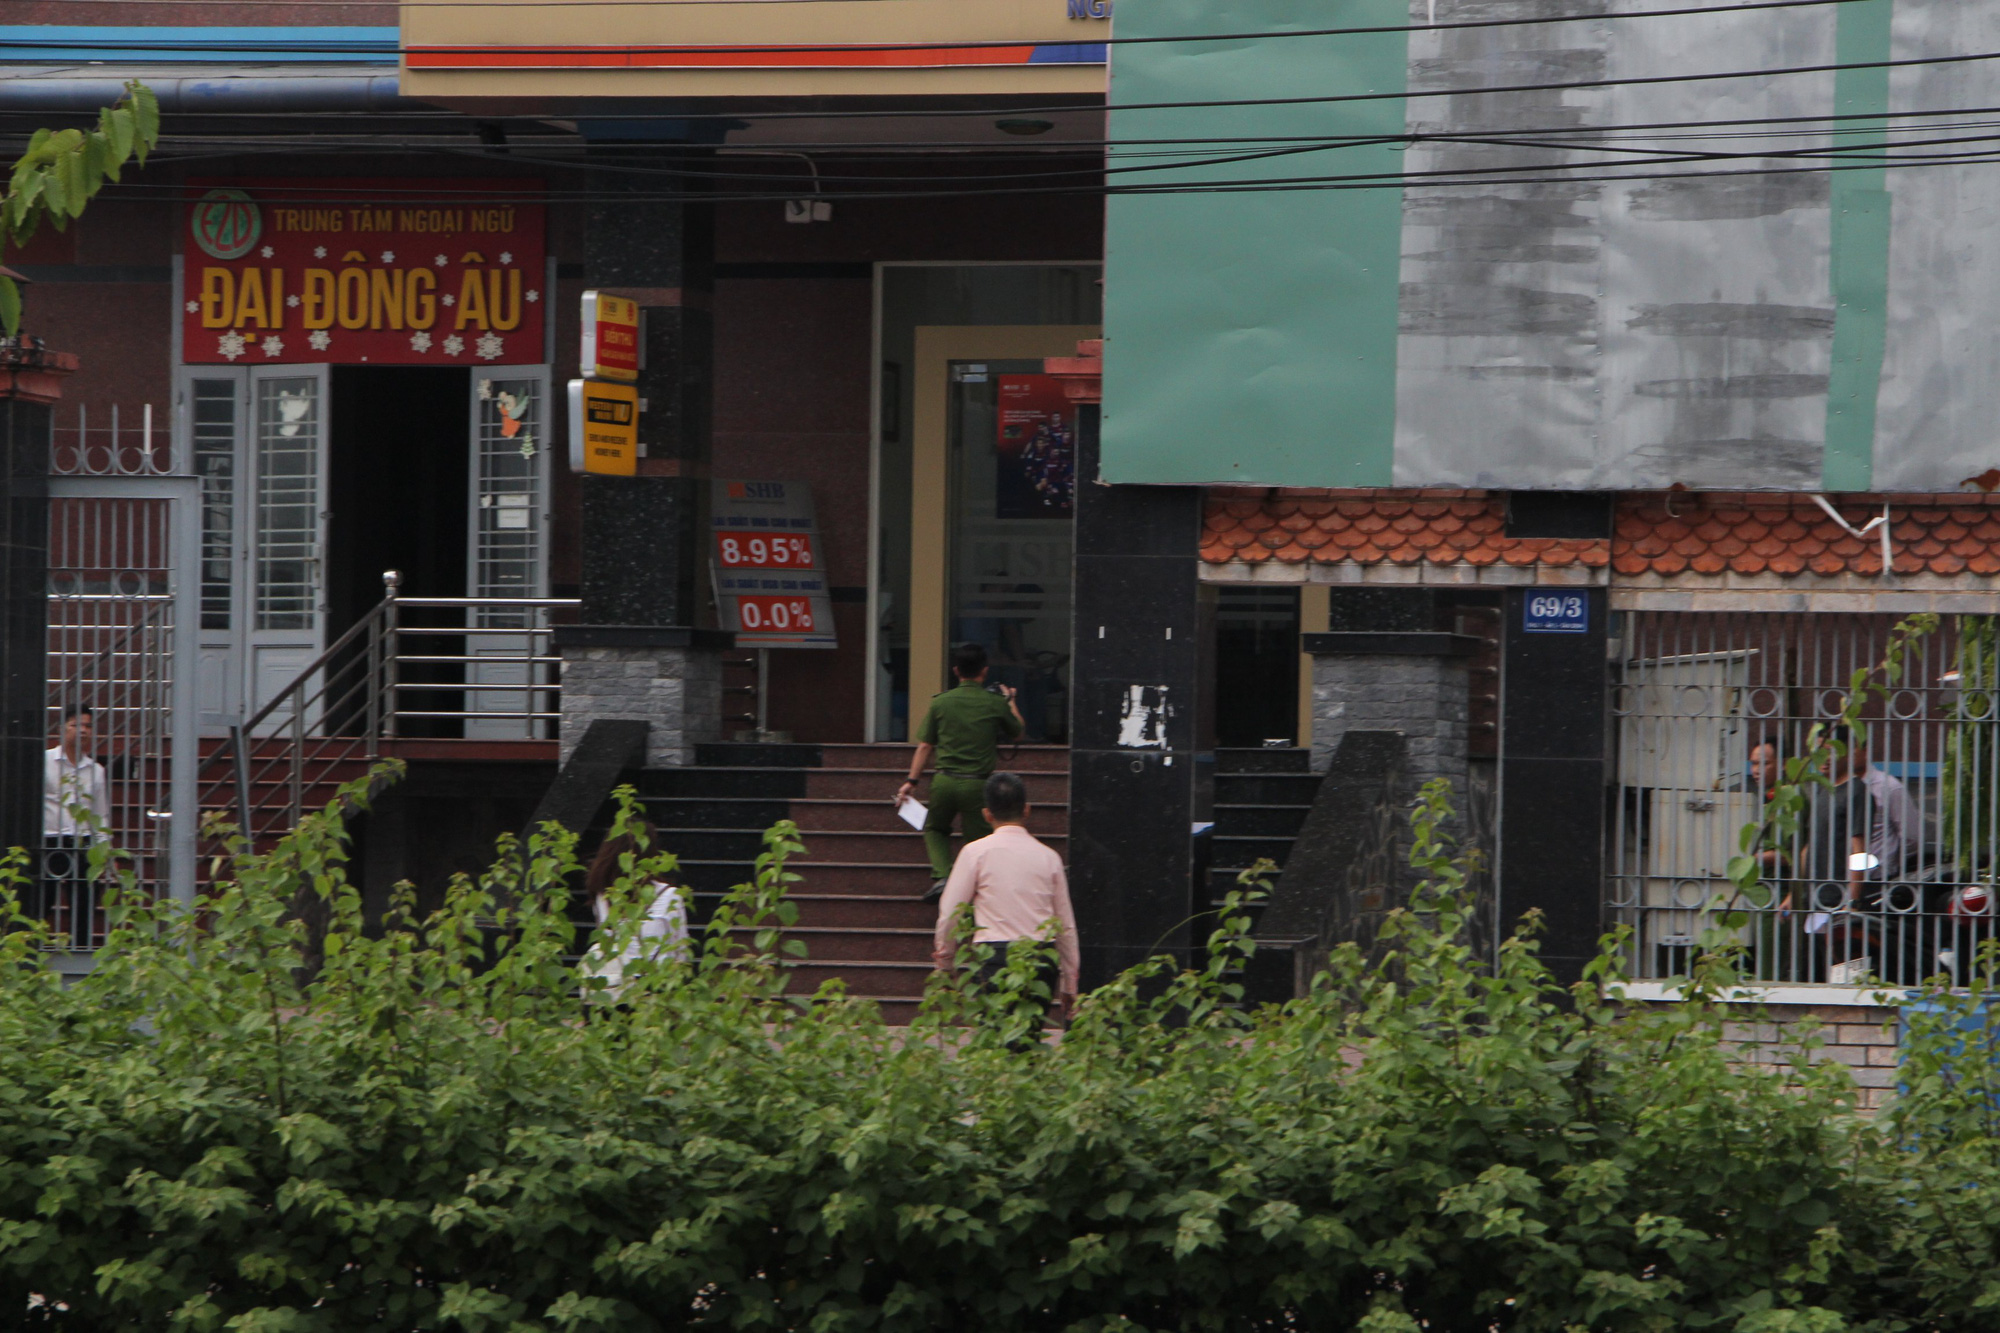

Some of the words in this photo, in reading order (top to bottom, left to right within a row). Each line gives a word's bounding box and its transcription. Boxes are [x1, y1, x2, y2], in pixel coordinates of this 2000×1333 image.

[1067, 0, 1112, 19] NG
[274, 208, 343, 232] TRUNG
[350, 204, 393, 232] TÂM
[401, 208, 463, 238] NGOẠI
[471, 204, 516, 233] NGỮ
[199, 267, 284, 343] ĐẠI
[301, 250, 437, 330] ĐÔNG
[454, 251, 522, 331] ÂU
[745, 482, 785, 498] SHB
[721, 538, 812, 564] 8.95%
[742, 602, 812, 628] 0.0%
[1530, 596, 1582, 618] 69/3
